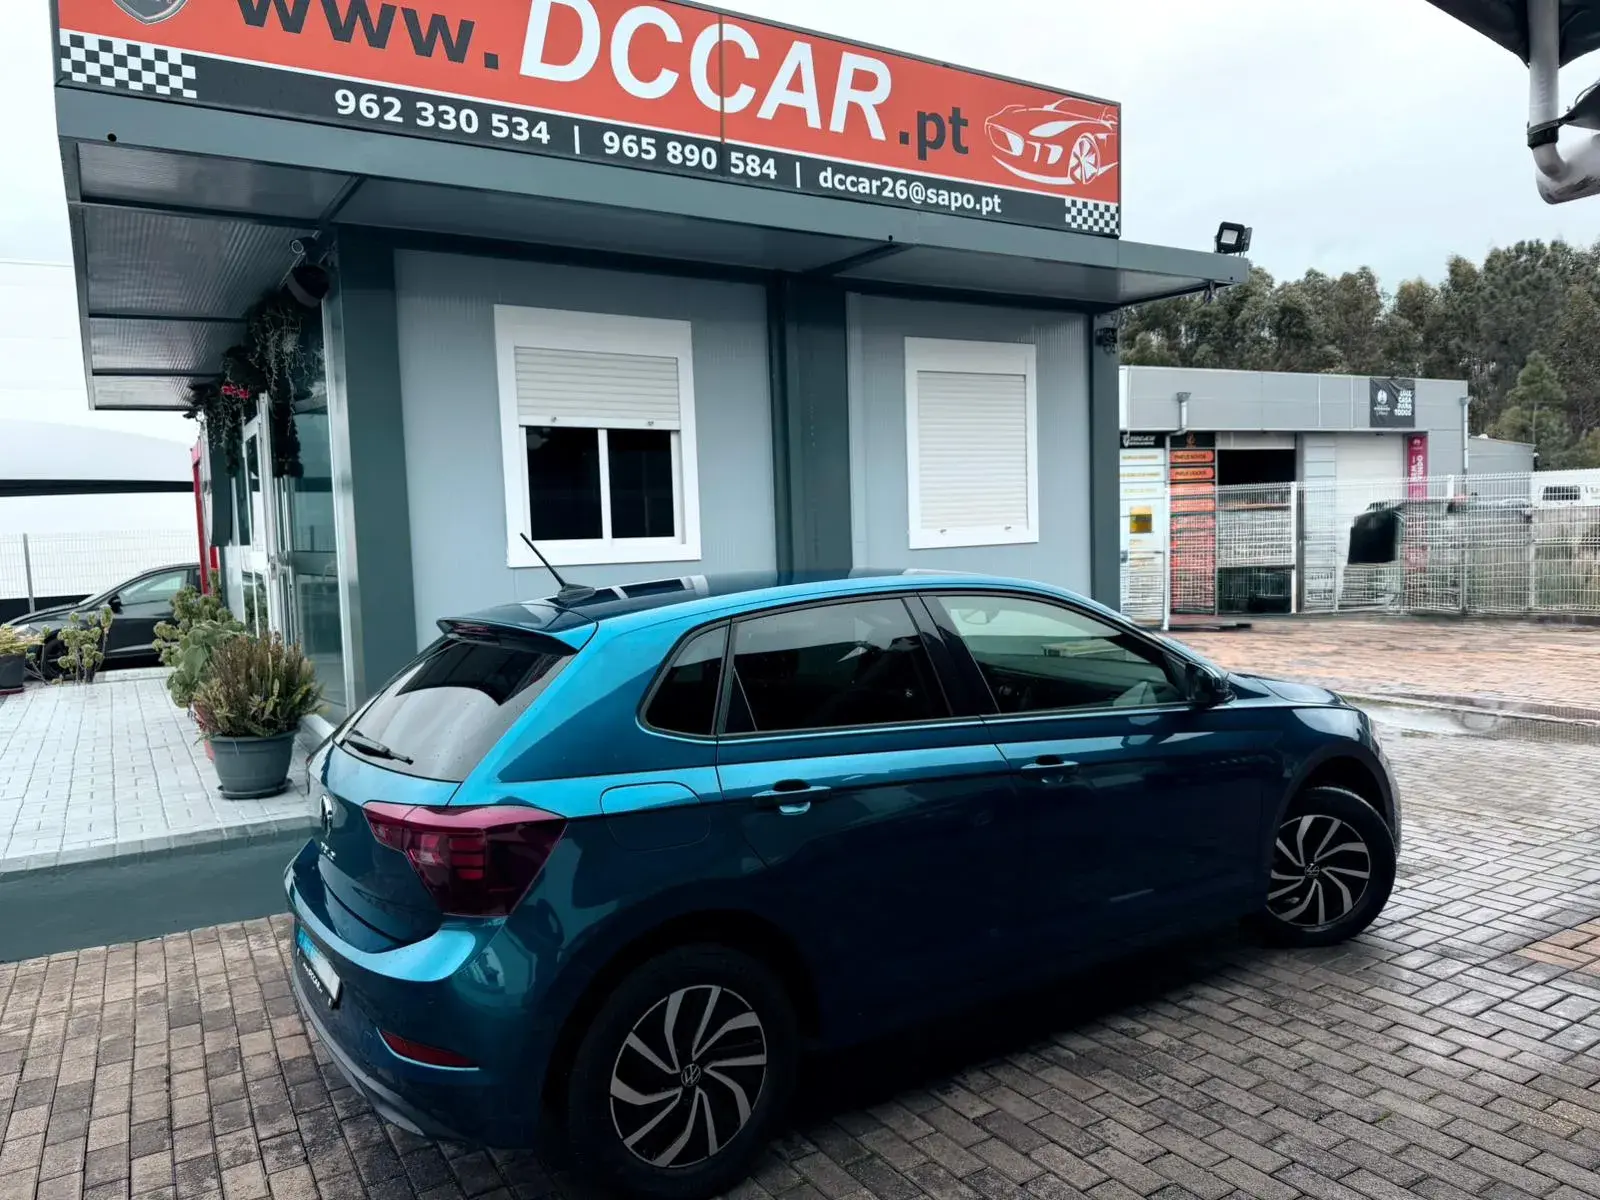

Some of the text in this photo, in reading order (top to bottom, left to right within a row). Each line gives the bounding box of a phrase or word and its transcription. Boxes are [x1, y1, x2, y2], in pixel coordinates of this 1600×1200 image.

[335, 88, 404, 123] 962
[415, 101, 479, 134] 330
[491, 113, 551, 145] 534
[602, 131, 657, 161] 965
[666, 140, 718, 170] 890
[730, 151, 778, 180] 584
[818, 166, 1002, 214] dccar26@sapo.pt
